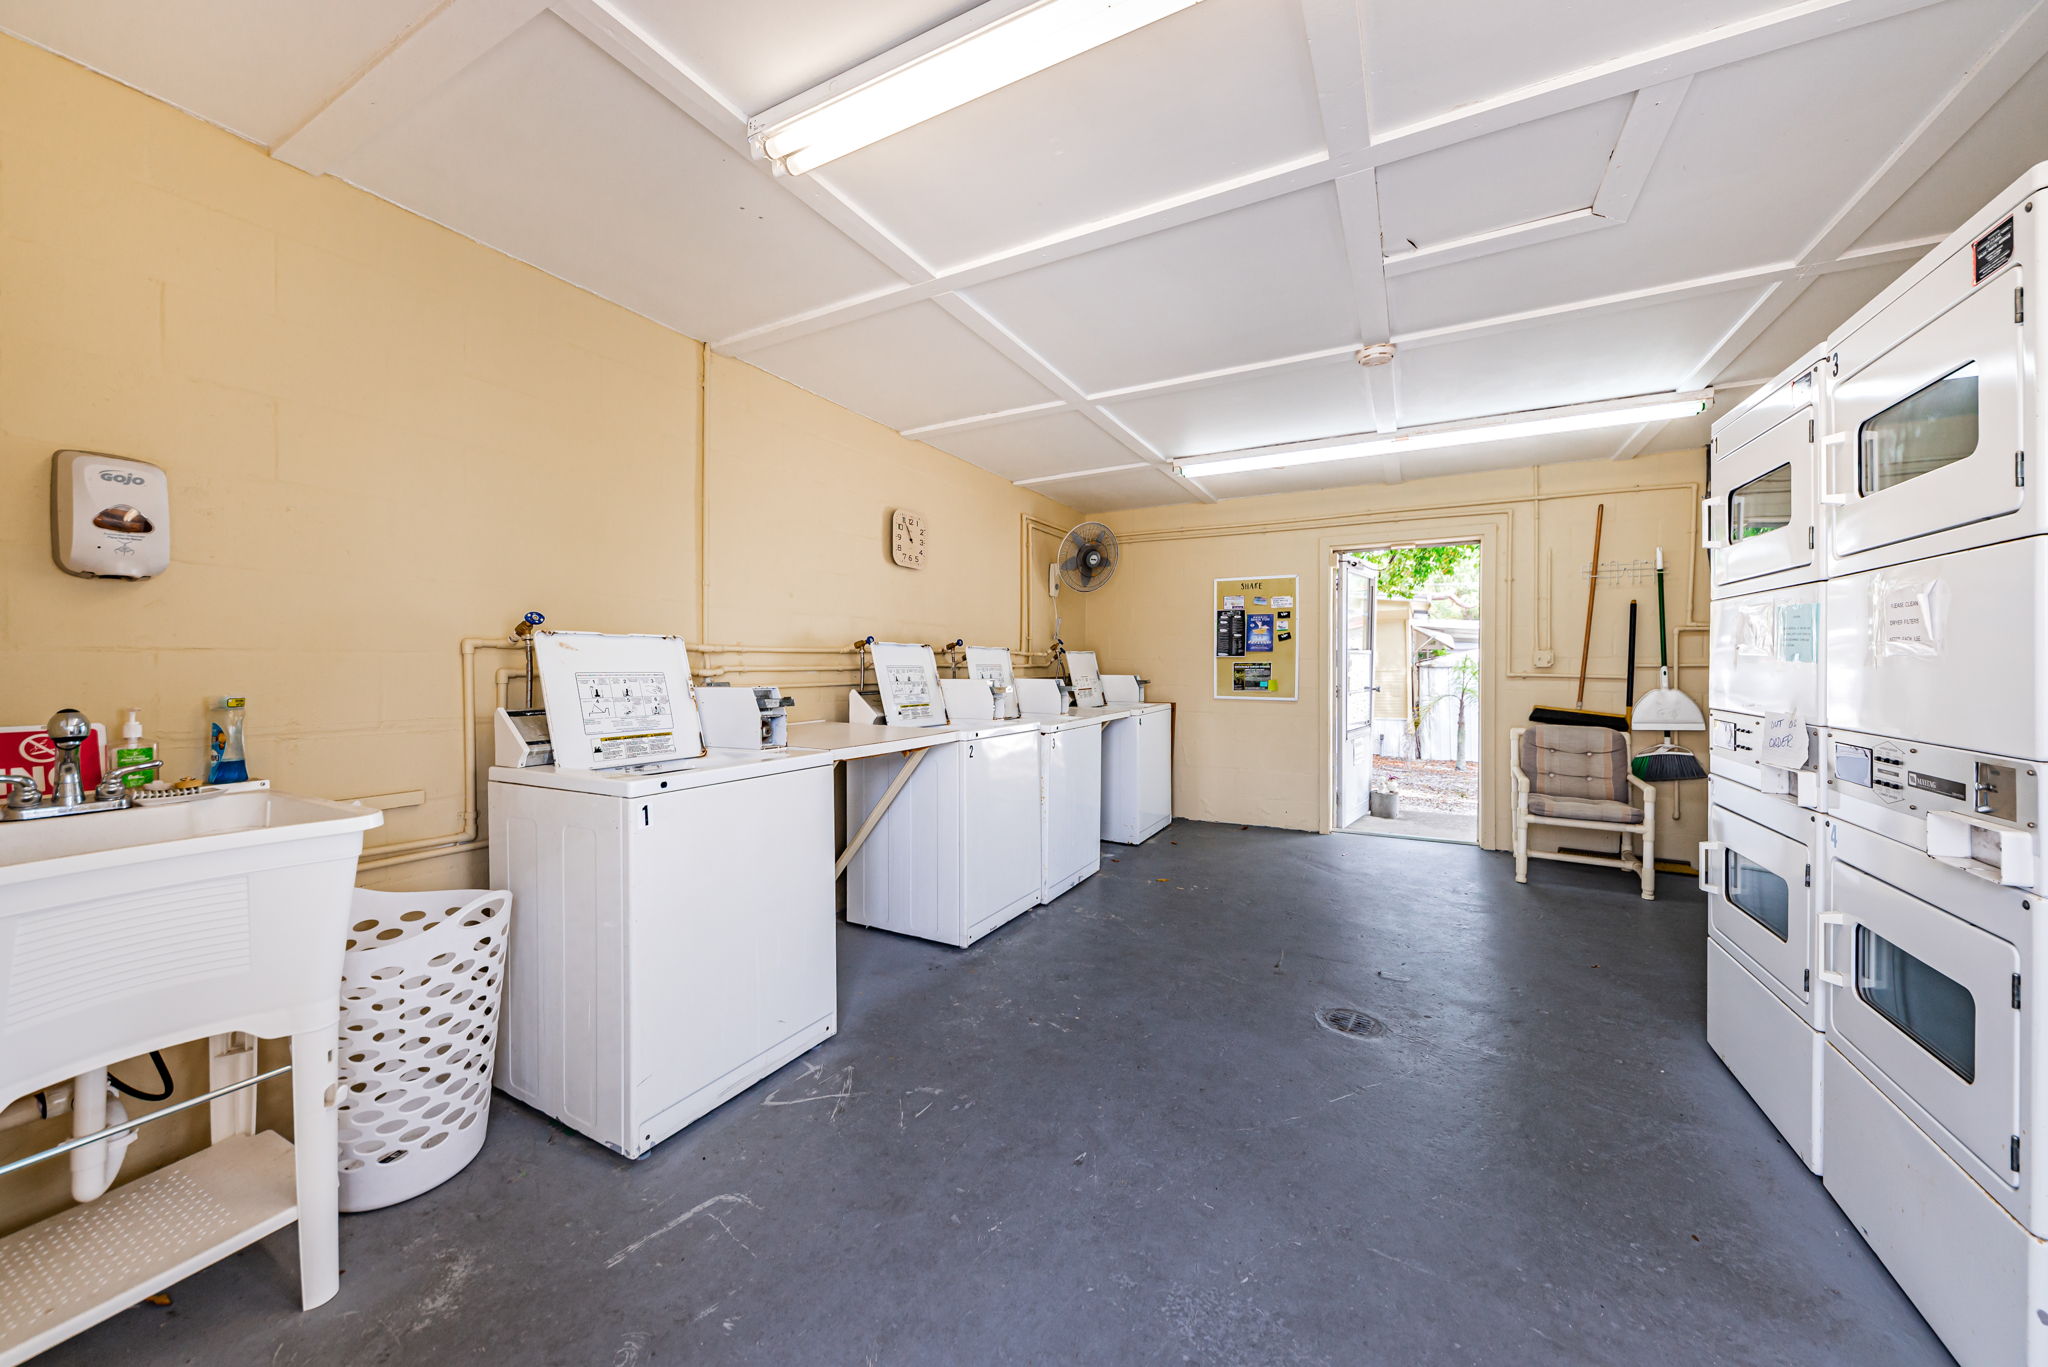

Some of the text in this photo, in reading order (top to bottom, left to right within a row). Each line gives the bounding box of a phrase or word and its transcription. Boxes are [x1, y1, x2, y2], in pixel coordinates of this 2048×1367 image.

[1833, 352, 1839, 377] 3
[99, 470, 145, 486] GOJO
[908, 518, 914, 526] 12
[897, 533, 902, 541] 9
[897, 544, 902, 552] 8
[902, 552, 907, 560] 7
[908, 554, 913, 562] 6
[914, 555, 919, 563] 5
[1905, 600, 1919, 608] CLEAN
[969, 744, 974, 759] 2
[641, 804, 649, 826] 1
[1831, 824, 1838, 849] 4
